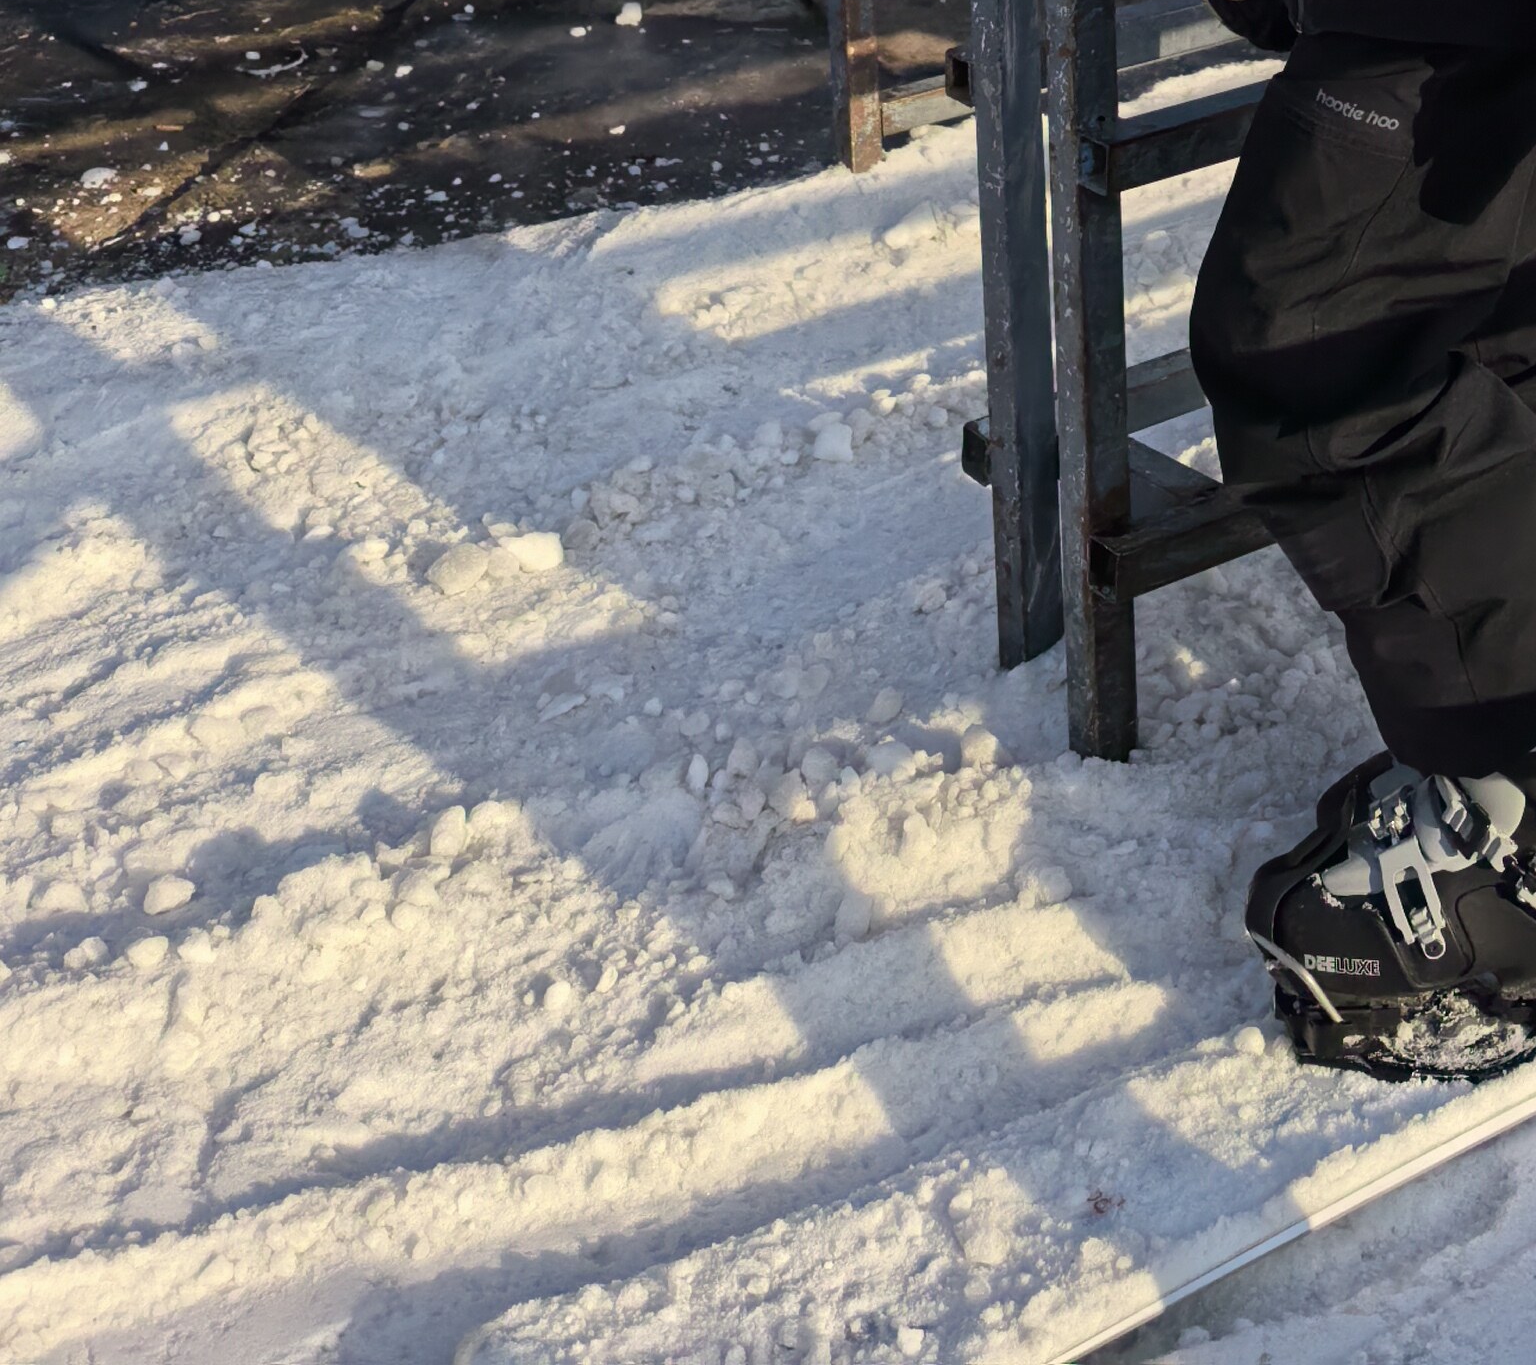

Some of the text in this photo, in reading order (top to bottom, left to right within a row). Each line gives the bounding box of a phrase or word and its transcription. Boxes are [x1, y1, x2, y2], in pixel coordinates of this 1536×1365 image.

[1315, 88, 1400, 131] hootie hoo
[1303, 954, 1381, 976] DEELUXE
